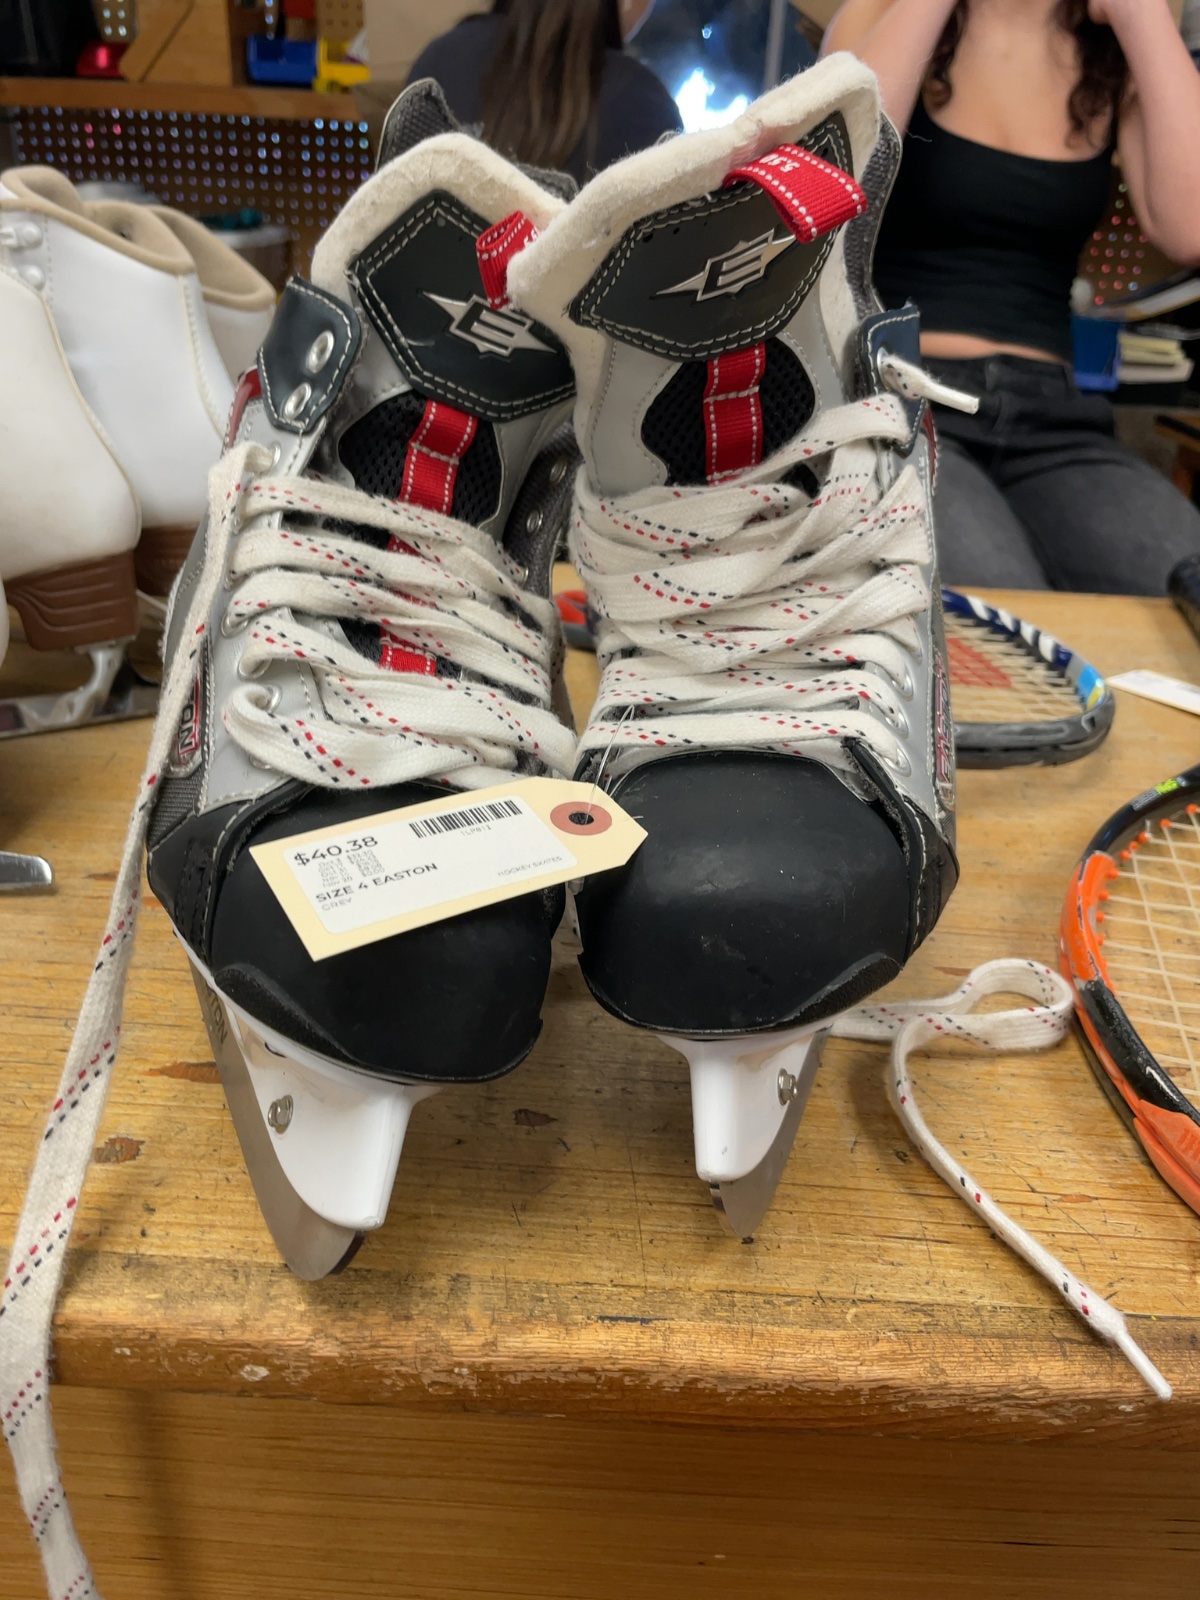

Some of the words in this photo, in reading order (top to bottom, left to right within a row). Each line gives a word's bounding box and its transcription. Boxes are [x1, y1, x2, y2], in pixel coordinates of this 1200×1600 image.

[294, 836, 378, 866] $40.38
[497, 863, 532, 877] HOCKEY
[532, 856, 563, 868] SKATES
[316, 885, 354, 902] SIZE
[358, 881, 369, 890] 4
[372, 863, 438, 886] EASTON
[321, 898, 352, 911] GREY
